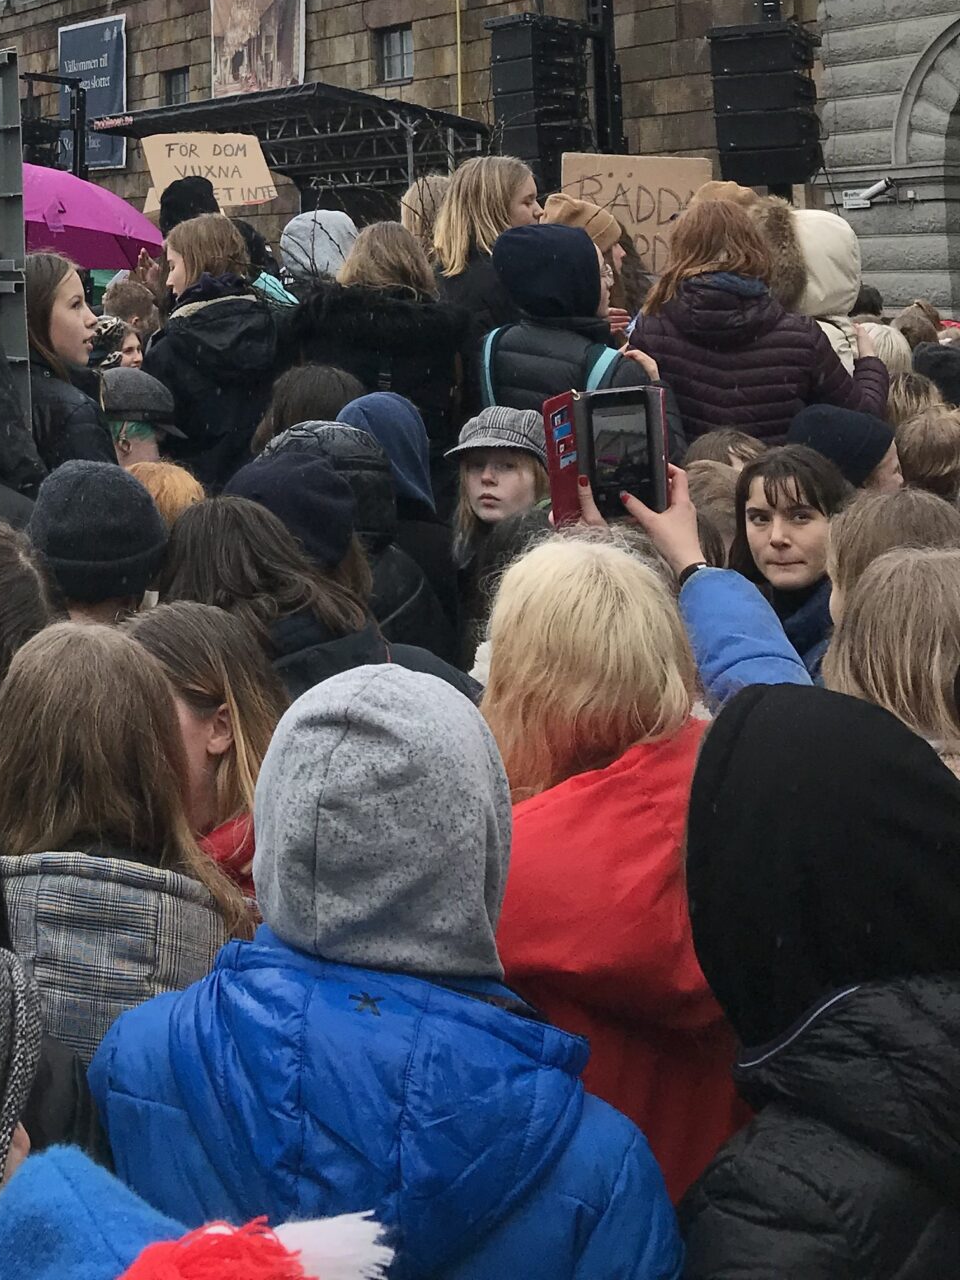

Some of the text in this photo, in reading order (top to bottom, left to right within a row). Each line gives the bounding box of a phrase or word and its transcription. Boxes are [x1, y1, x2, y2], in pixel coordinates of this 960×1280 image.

[165, 142, 247, 158] FÖR DOM
[174, 164, 242, 179] VUXNA
[213, 186, 277, 202] ET INTE
[578, 172, 696, 226] RÄDD
